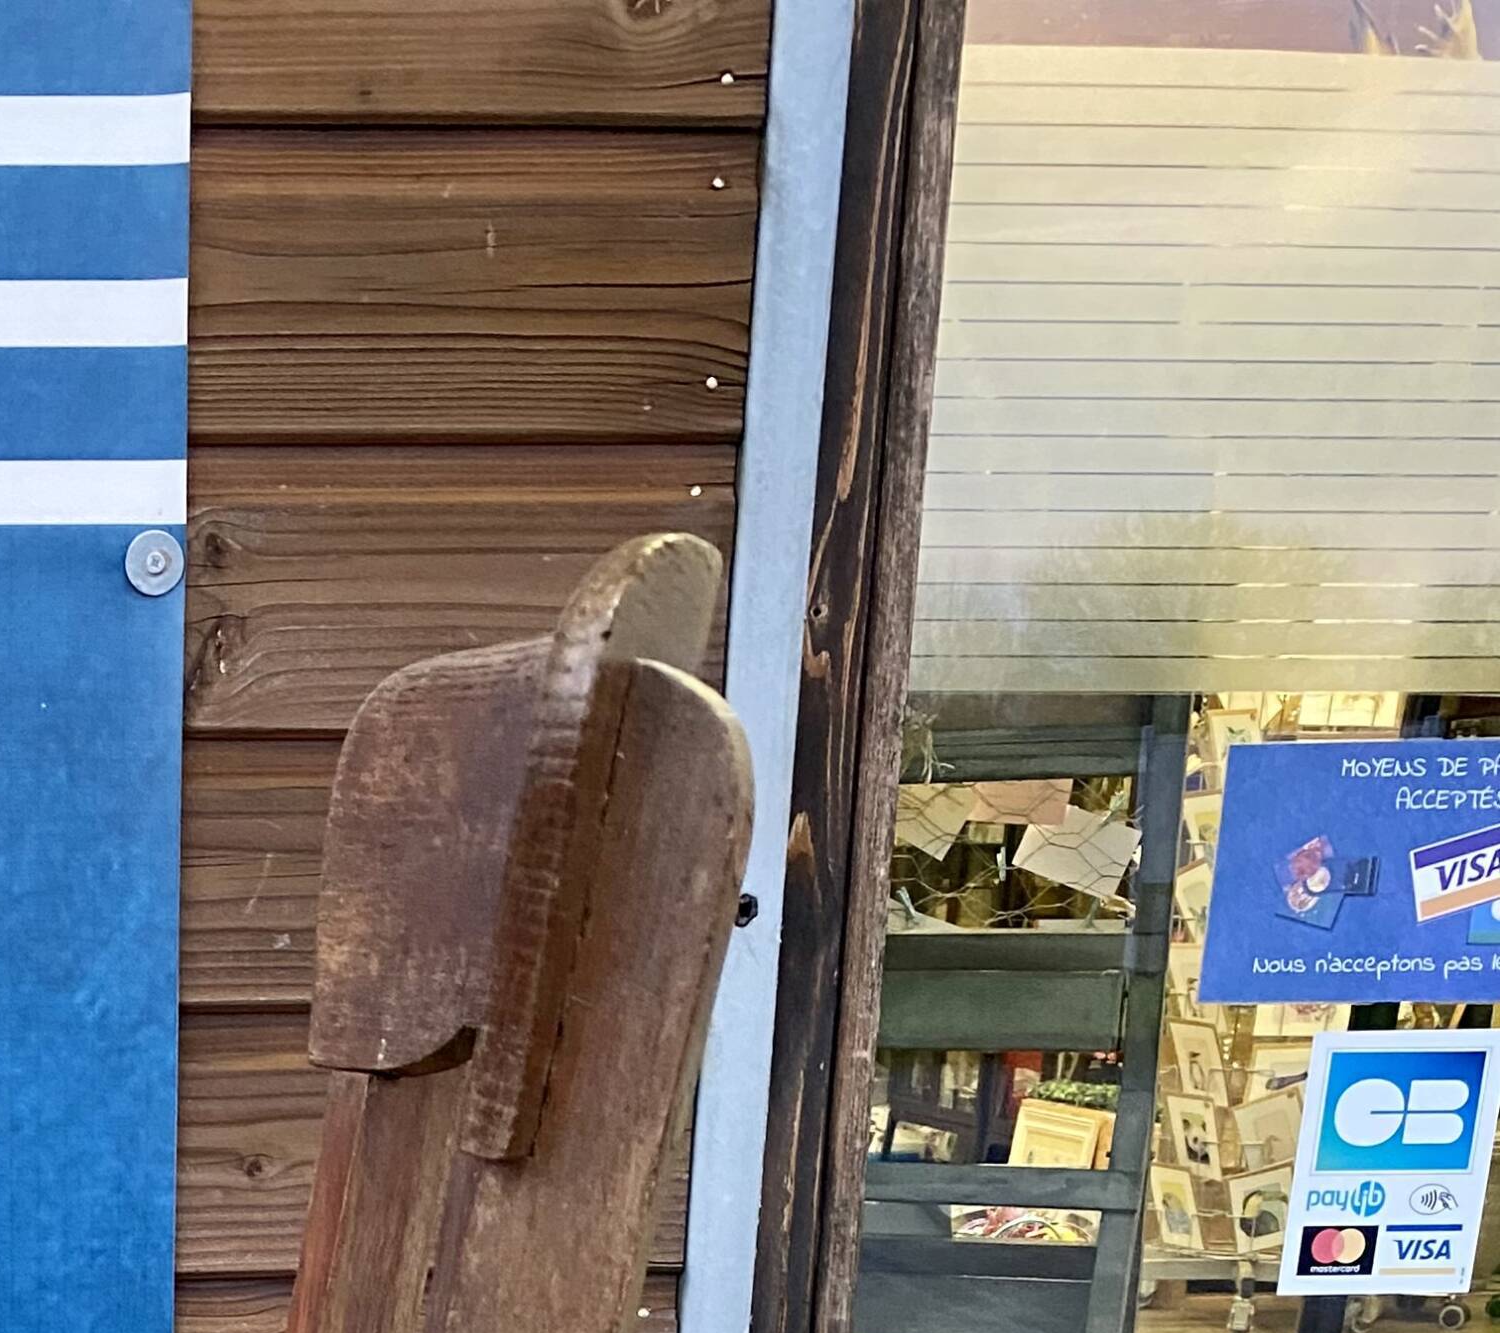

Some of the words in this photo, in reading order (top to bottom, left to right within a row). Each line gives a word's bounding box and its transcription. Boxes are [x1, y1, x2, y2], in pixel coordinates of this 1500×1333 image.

[1341, 757, 1426, 777] MOYENS
[1437, 757, 1468, 777] DE
[1434, 849, 1500, 890] VISA
[1252, 956, 1306, 974] Nous
[1315, 953, 1435, 981] n'acceptons
[1443, 955, 1483, 980] pas
[1334, 1078, 1469, 1147] CB
[1393, 1239, 1451, 1260] VISA
[1310, 1264, 1361, 1273] mastercard
